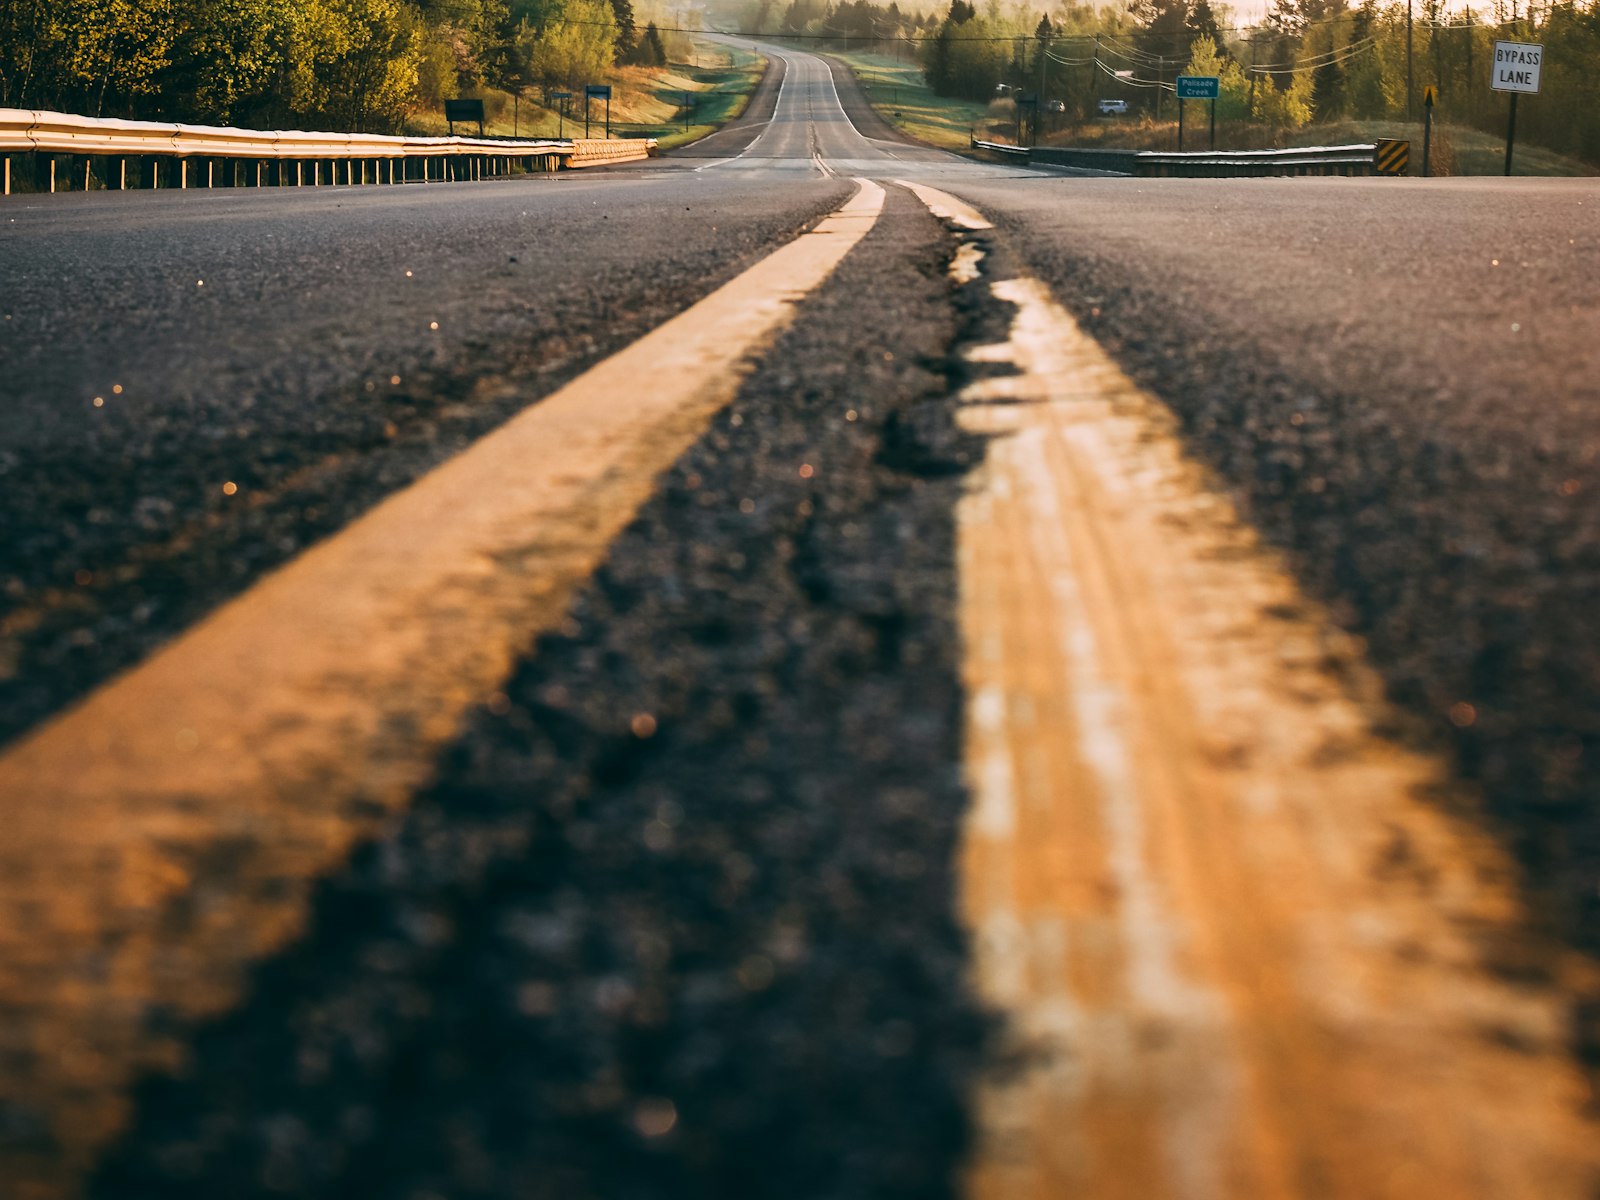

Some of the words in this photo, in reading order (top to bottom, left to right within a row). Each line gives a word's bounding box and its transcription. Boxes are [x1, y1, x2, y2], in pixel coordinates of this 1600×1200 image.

[1497, 49, 1539, 65] BYPASS
[1500, 70, 1532, 85] LANE
[1186, 88, 1209, 96] Creek
